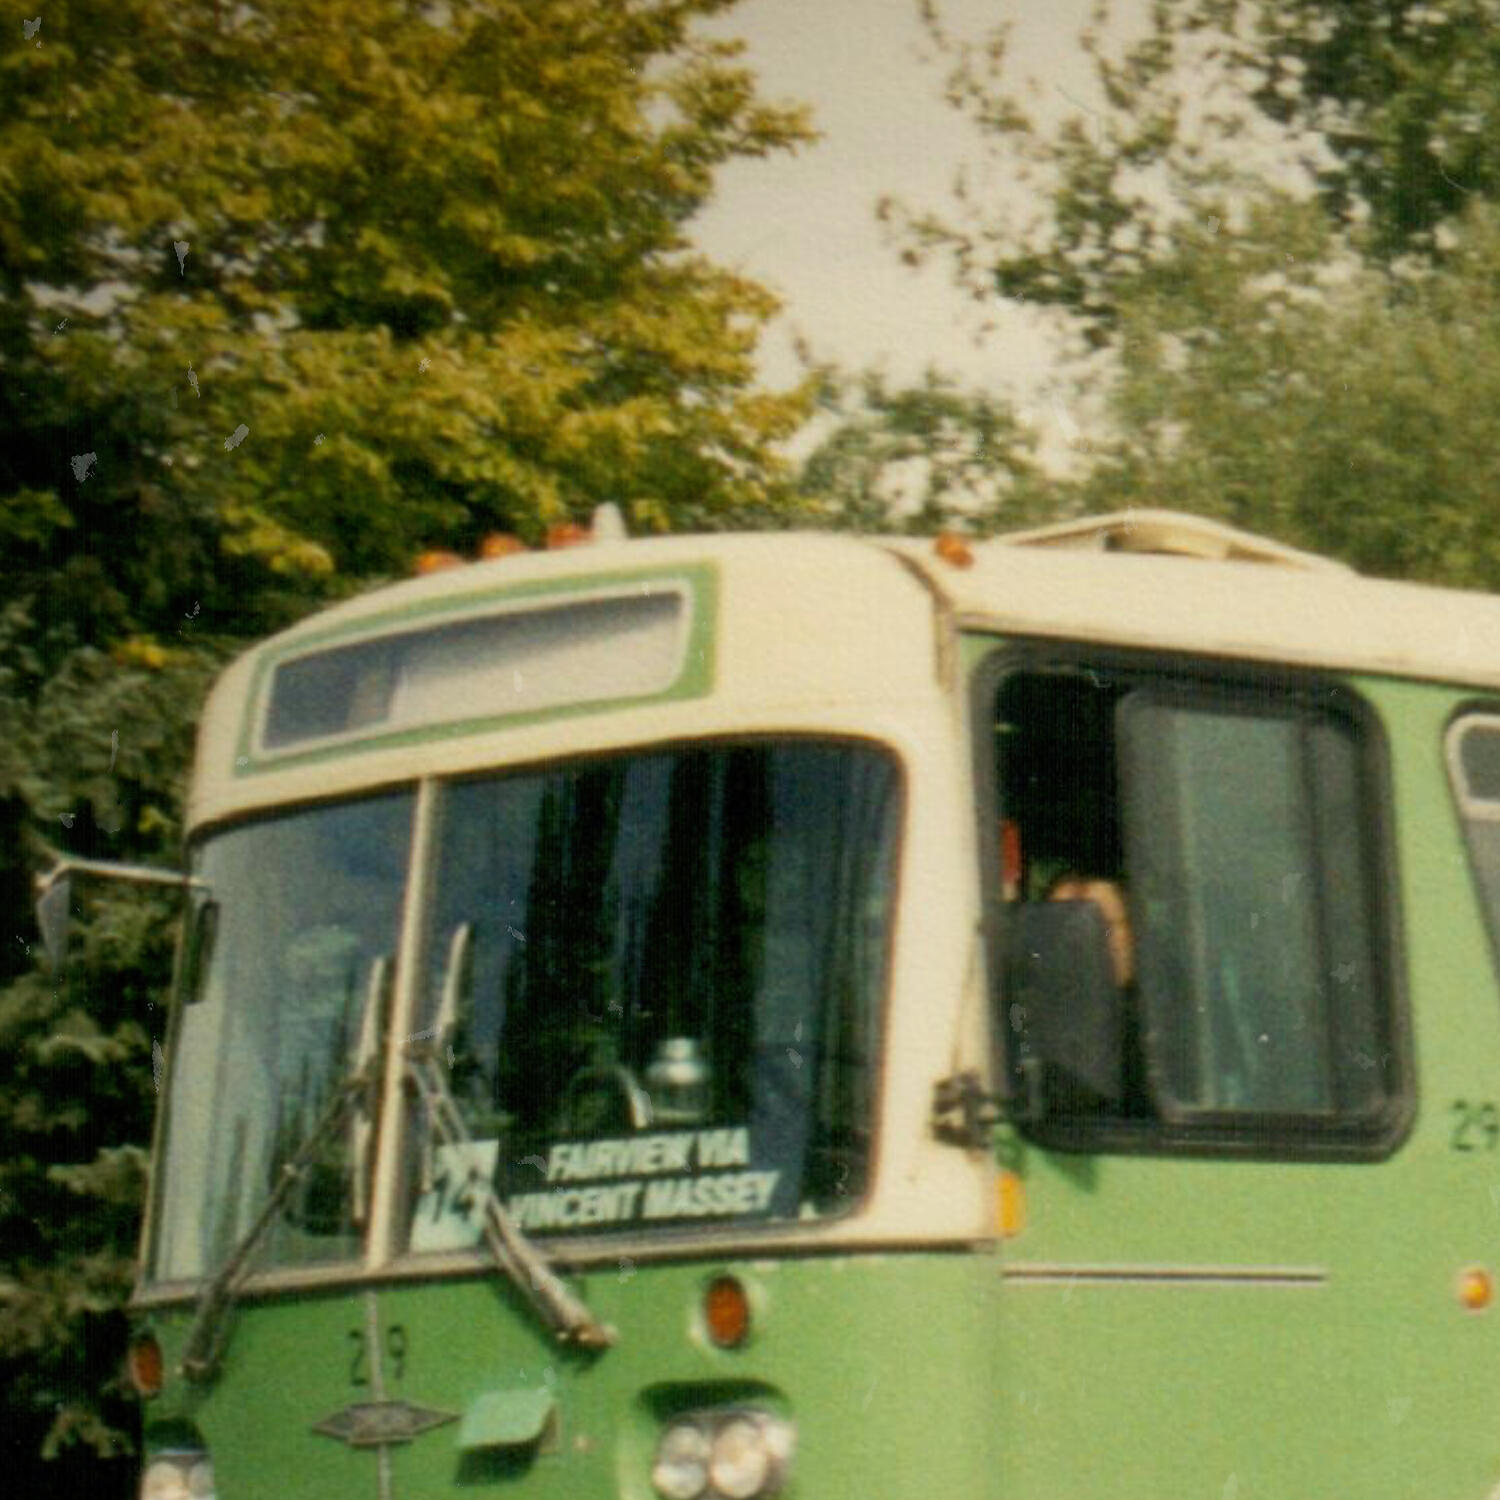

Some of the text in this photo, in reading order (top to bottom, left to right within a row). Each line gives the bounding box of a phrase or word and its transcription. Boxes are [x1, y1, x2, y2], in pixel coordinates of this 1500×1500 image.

[546, 1126, 751, 1182] FAIRVIEW VIA
[1449, 1098, 1500, 1153] 29
[508, 1169, 781, 1230] VINCENT MASSEY
[348, 1323, 407, 1386] 29
